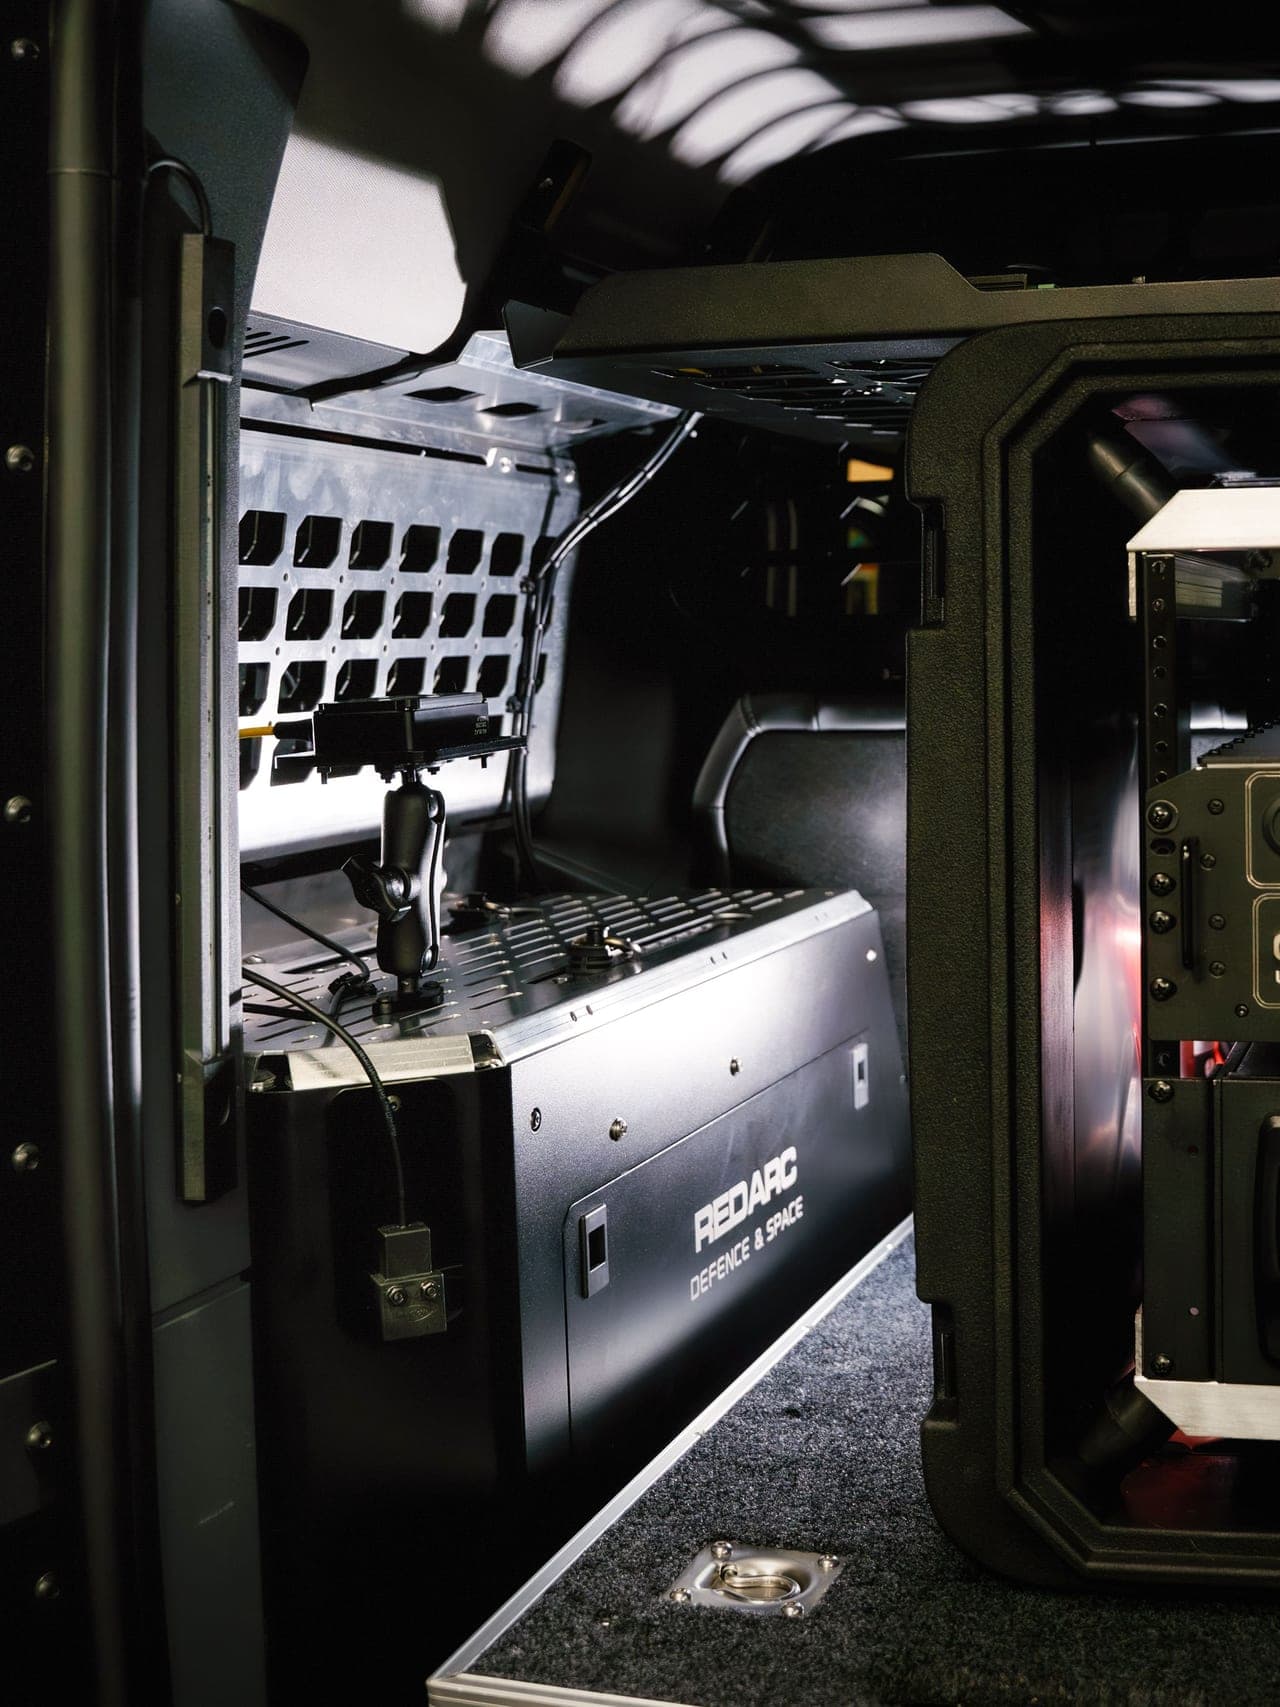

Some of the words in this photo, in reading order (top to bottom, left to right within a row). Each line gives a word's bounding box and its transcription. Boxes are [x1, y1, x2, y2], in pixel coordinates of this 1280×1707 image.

[690, 1235, 751, 1302] DEFENCE
[754, 1226, 765, 1251] &
[766, 1194, 804, 1243] SPACE
[694, 1146, 798, 1254] REDARC
